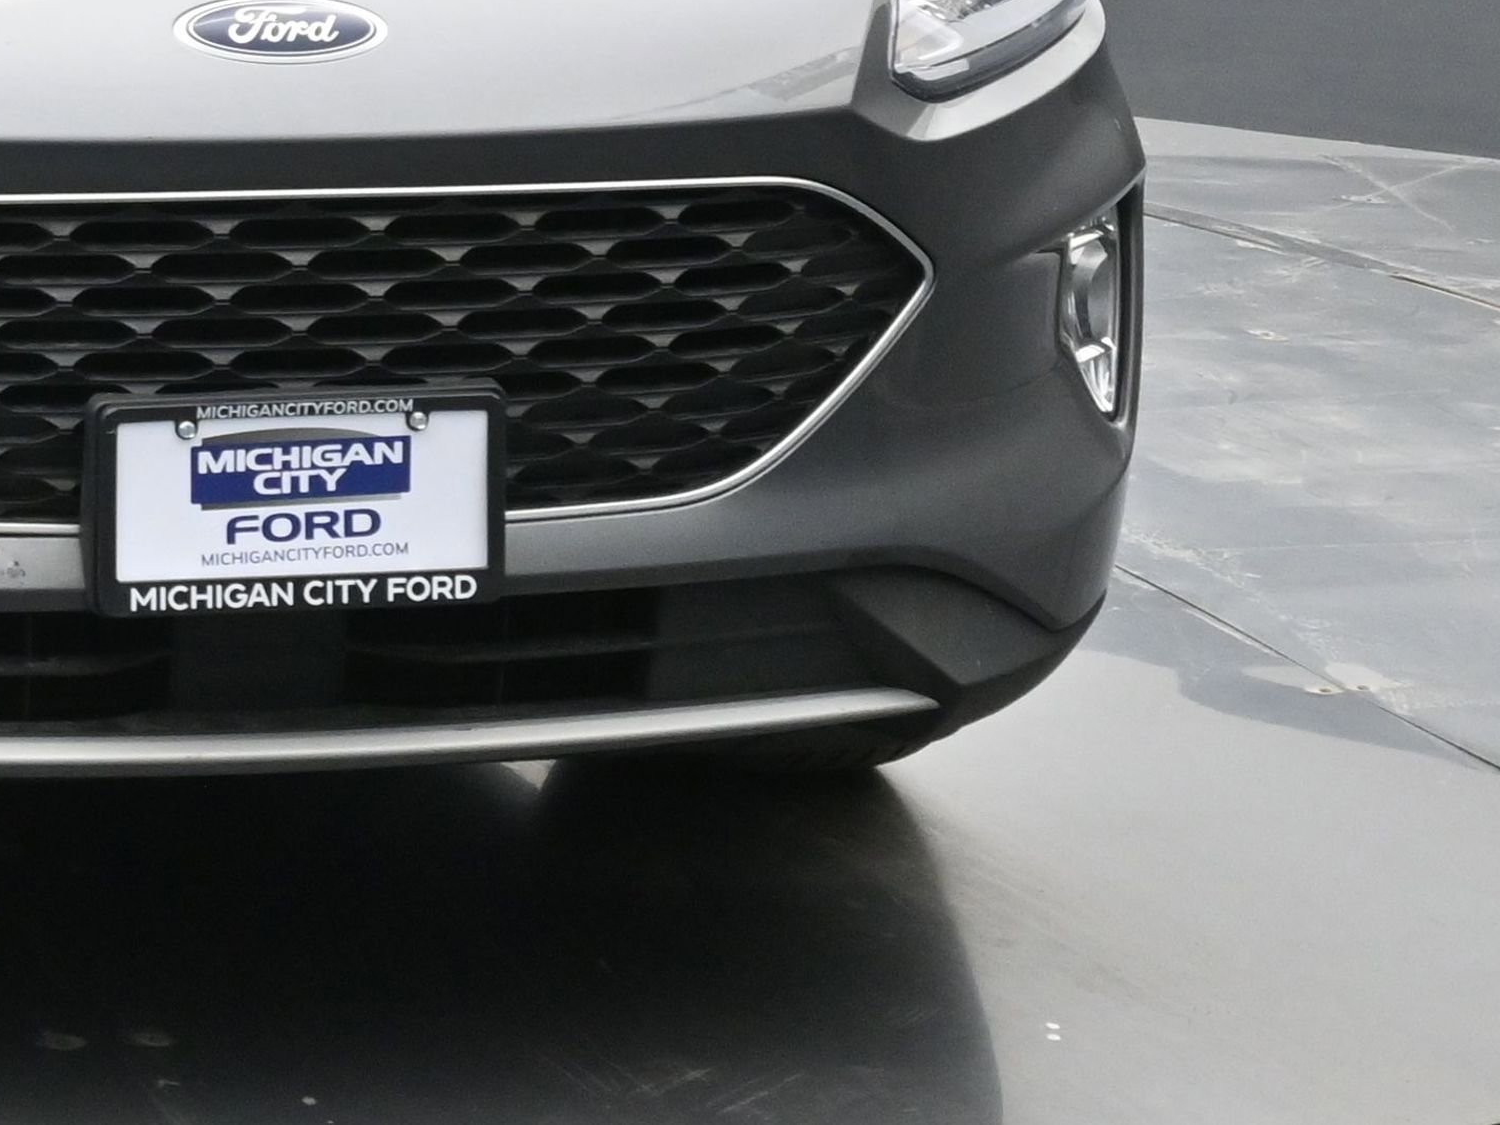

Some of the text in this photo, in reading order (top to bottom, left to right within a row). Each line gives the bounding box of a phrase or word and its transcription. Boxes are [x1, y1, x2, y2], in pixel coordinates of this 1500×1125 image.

[227, 5, 340, 44] Ford
[196, 398, 414, 420] MICHIGANCITYFORD.COM
[198, 441, 404, 475] MICHIGAN
[253, 467, 347, 497] CITY
[226, 508, 382, 545] FORD
[201, 542, 409, 567] MICHIGANCITYFORD.COM
[130, 574, 477, 612] MICHIGAN CITY FORD
